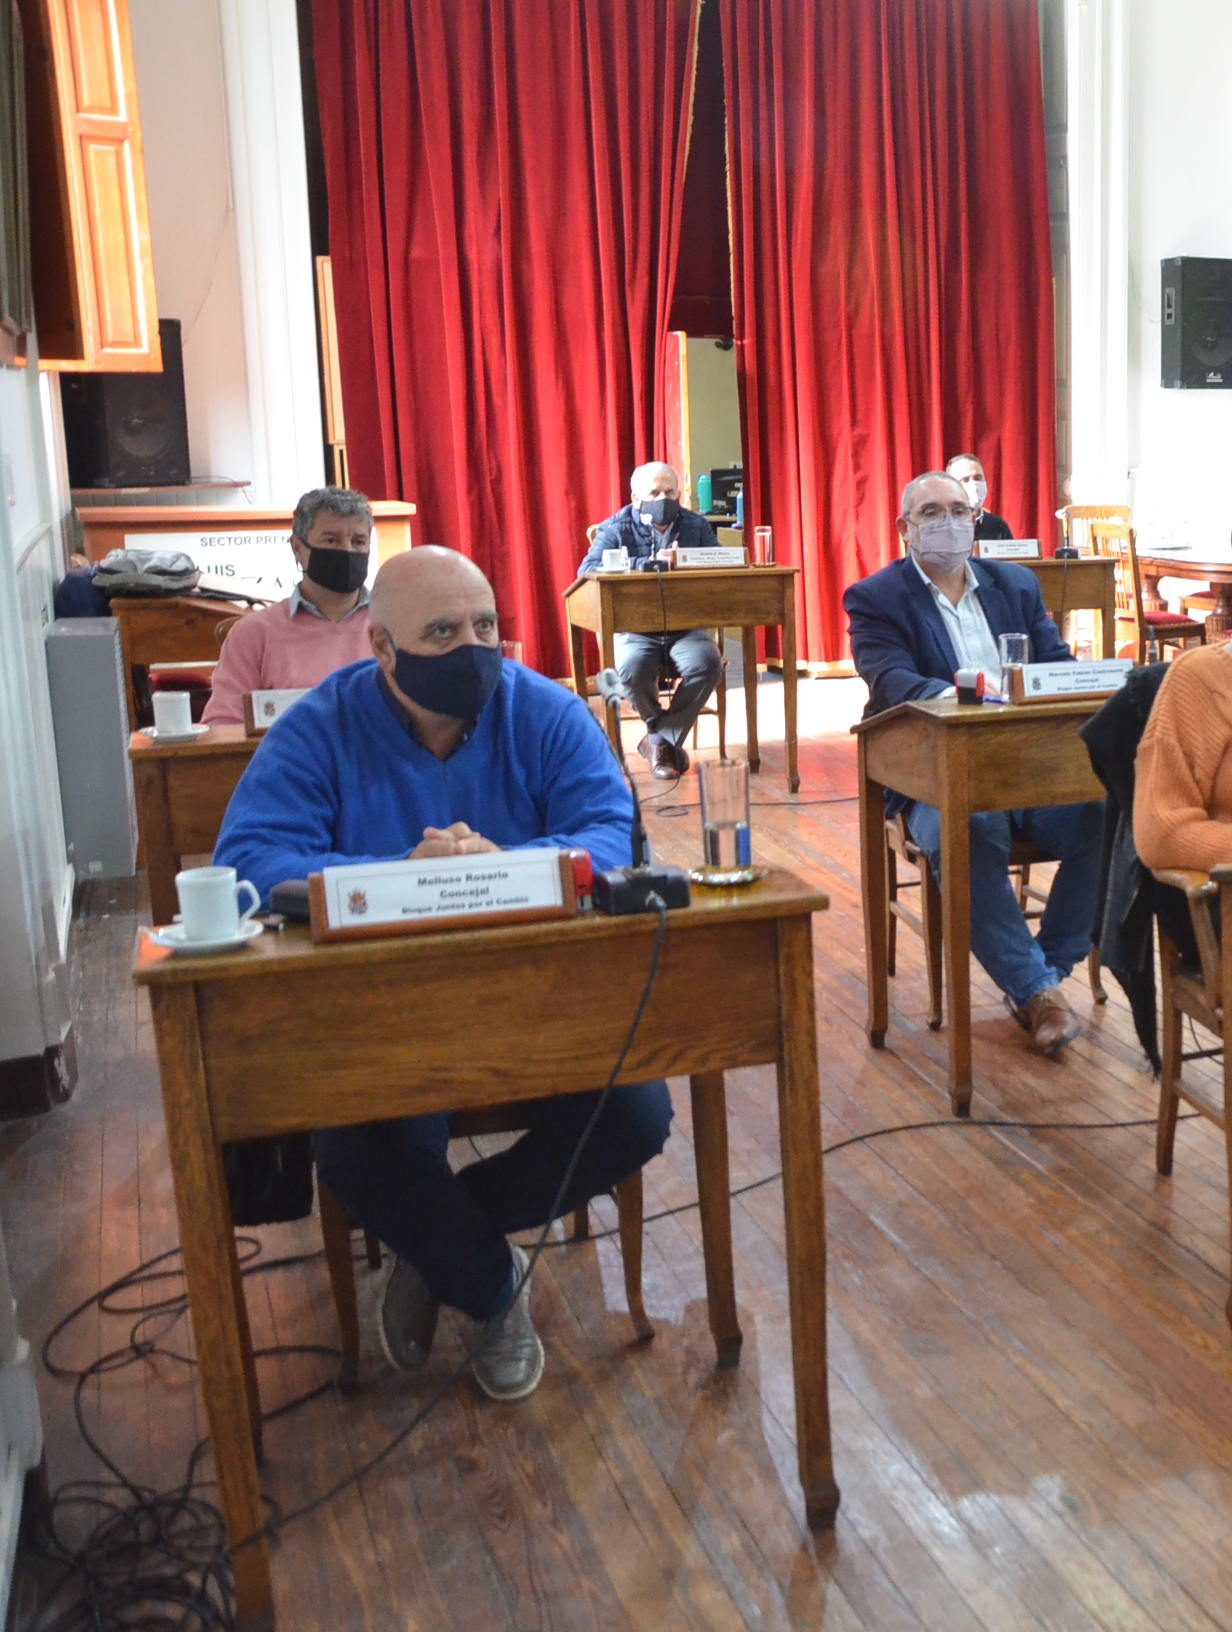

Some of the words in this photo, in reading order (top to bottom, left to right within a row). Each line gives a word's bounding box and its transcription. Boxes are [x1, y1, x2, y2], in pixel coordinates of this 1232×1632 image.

[200, 536, 252, 547] SECTOR
[466, 870, 509, 882] Rosario
[440, 886, 490, 898] Concejal
[402, 906, 432, 915] Bloque
[436, 902, 466, 911] Juntos
[468, 901, 483, 910] por
[496, 896, 530, 905] Cambio
